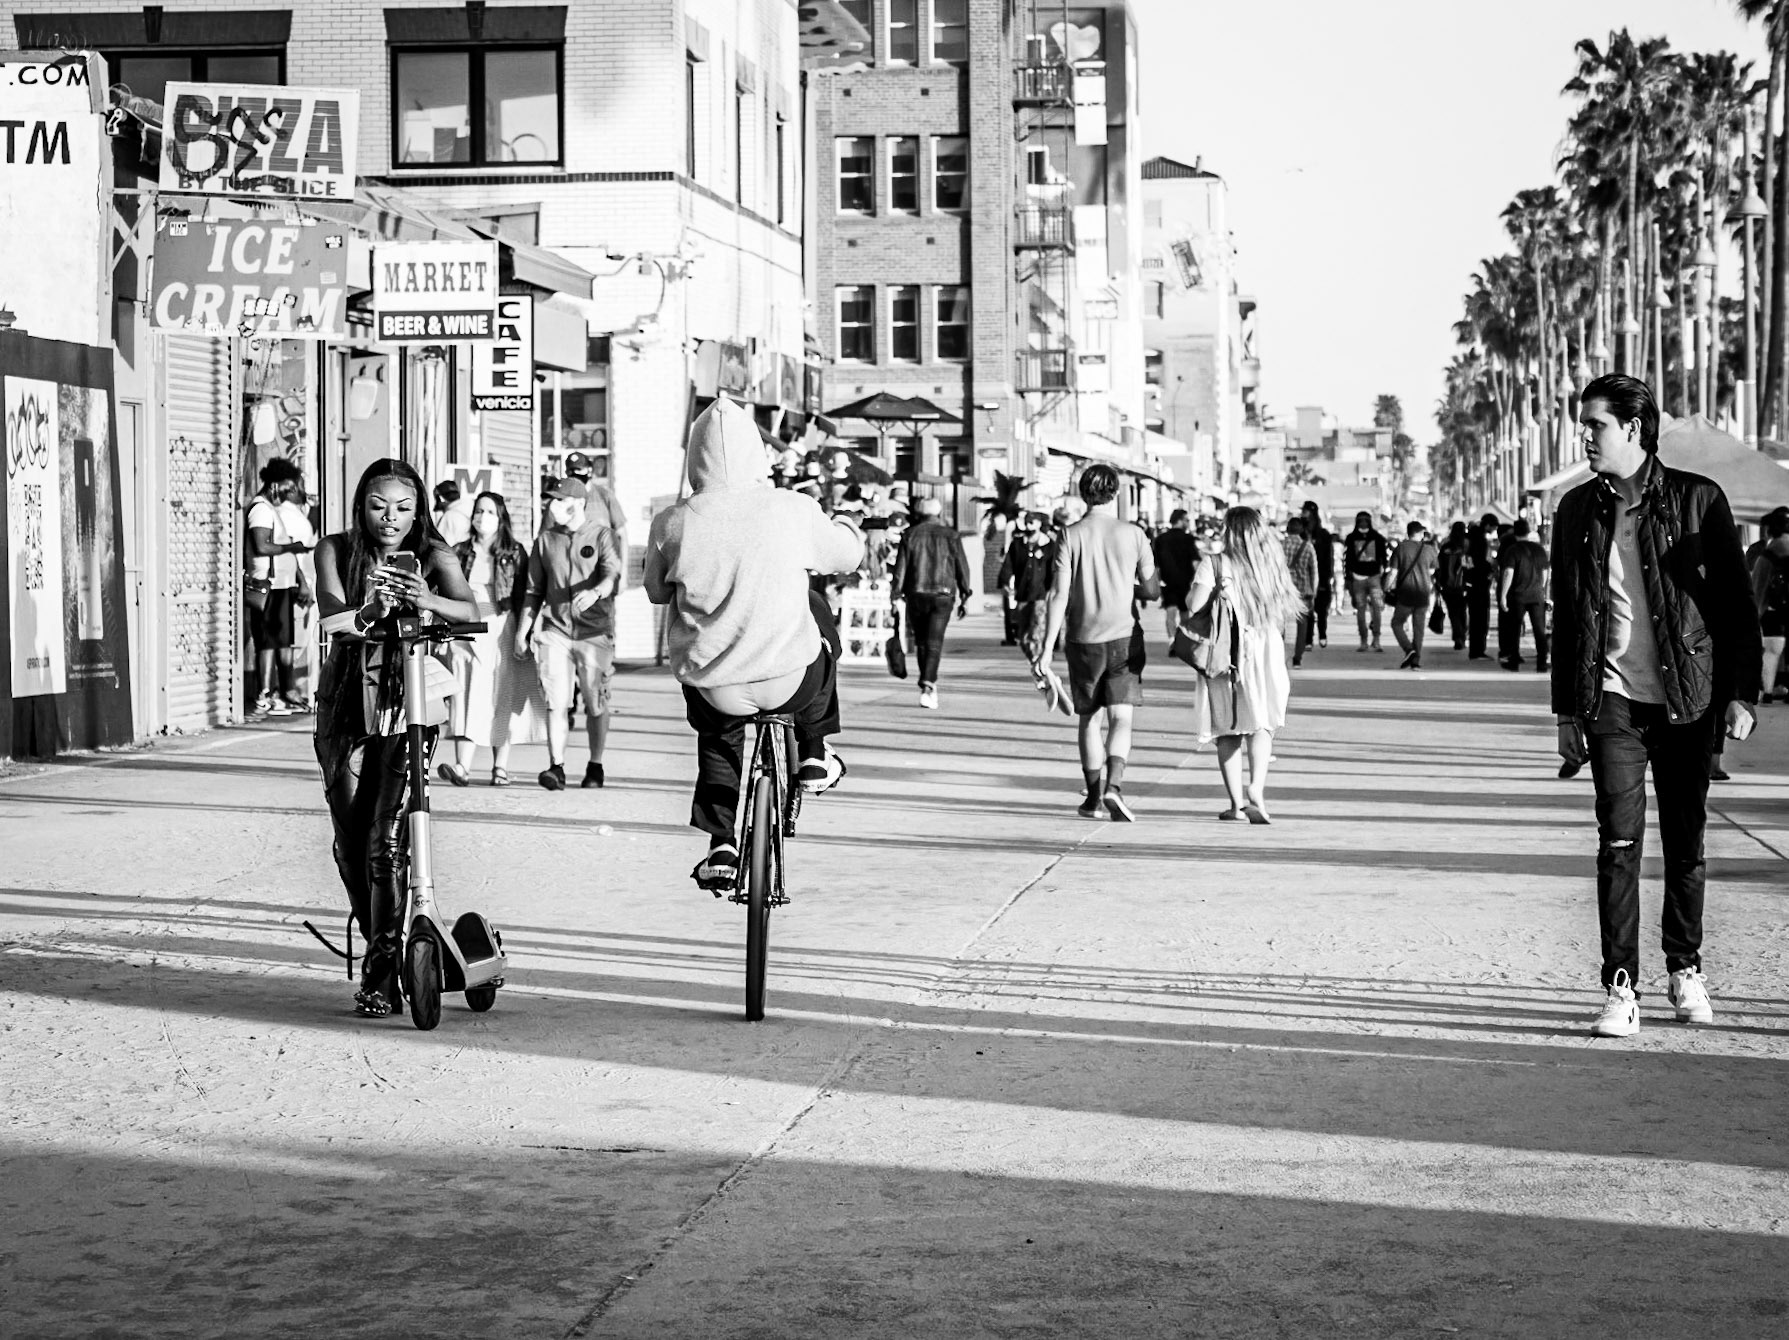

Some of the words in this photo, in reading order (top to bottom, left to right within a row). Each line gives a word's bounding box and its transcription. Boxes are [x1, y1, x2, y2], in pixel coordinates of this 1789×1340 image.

[0, 63, 90, 87] .COM
[174, 94, 344, 174] PIZZA
[178, 173, 206, 190] BY
[273, 177, 337, 196] SLICE
[207, 225, 299, 274] ICE
[384, 261, 487, 293] MARKET
[155, 282, 343, 333] CREAM
[383, 315, 426, 336] BEER
[427, 315, 442, 335] &
[443, 314, 489, 335] WINE
[492, 301, 521, 387] CAFE
[476, 396, 531, 410] venicia
